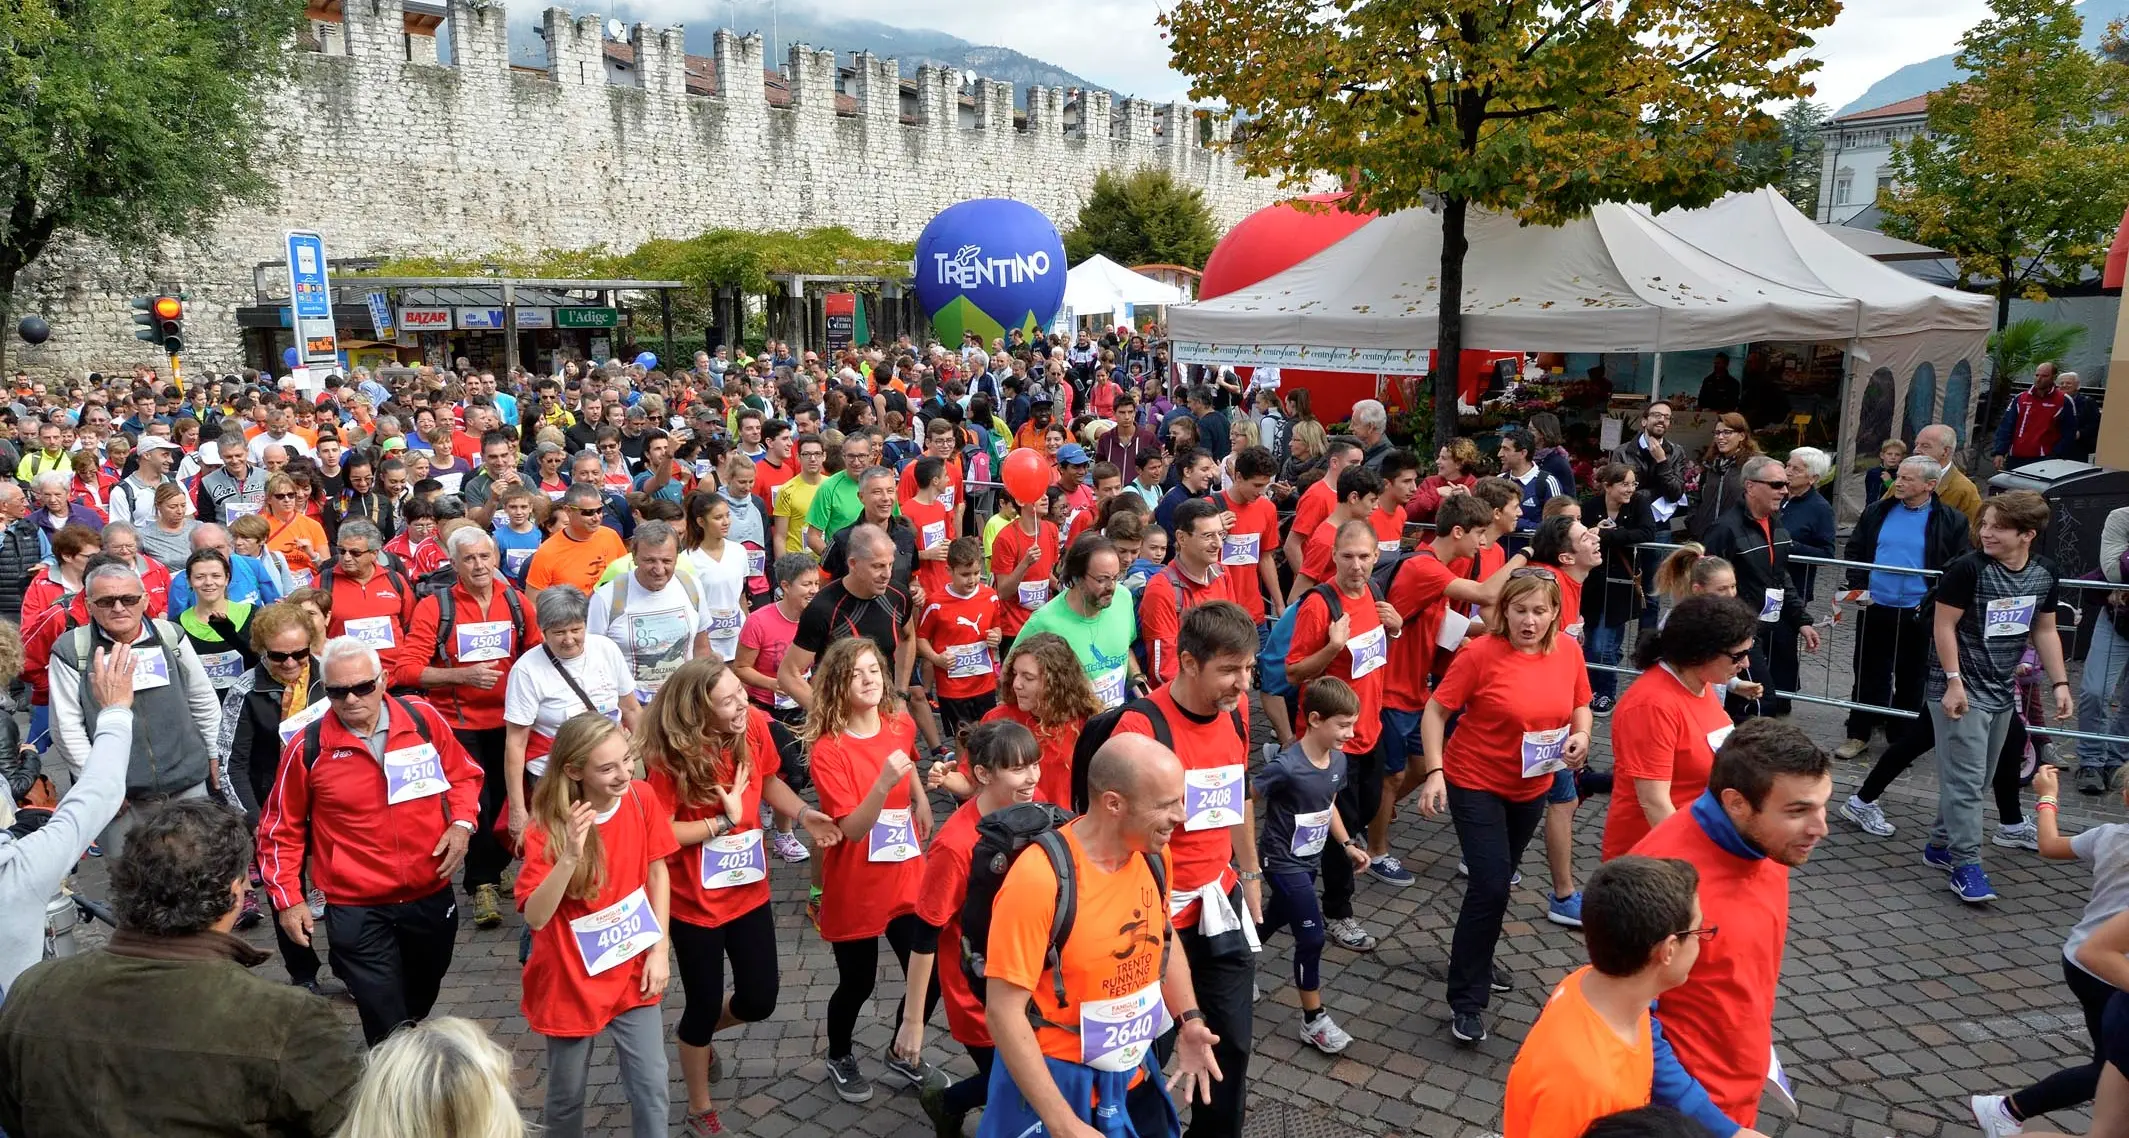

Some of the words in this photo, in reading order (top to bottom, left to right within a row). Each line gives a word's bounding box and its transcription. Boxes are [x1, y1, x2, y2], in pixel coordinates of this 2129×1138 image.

[934, 250, 1050, 289] TRENTINO
[405, 312, 448, 324] BAZAR
[568, 310, 609, 325] l'Adige
[1220, 344, 1252, 358] centrofiore
[1263, 345, 1298, 359] centrofiore
[1311, 346, 1348, 362] centrofiore
[1362, 349, 1402, 365] centrofiore
[1230, 544, 1252, 556] 2124
[1028, 590, 1045, 600] 2133
[715, 617, 738, 628] 2051
[1990, 610, 2025, 624] 3817
[358, 627, 385, 641] 4764
[470, 634, 501, 649] 4508
[636, 628, 658, 648] 85
[957, 653, 983, 667] 2053
[1361, 642, 1380, 661] 2070
[651, 666, 677, 675] BOLZANO
[402, 761, 436, 781] 4510
[1197, 787, 1232, 809] 2408
[717, 850, 754, 869] 4031
[597, 915, 641, 948] 4030
[1116, 953, 1152, 974] TRENTO
[1102, 964, 1150, 990] RUNNING
[1109, 977, 1149, 997] FESTIVAL
[1102, 1014, 1153, 1048] 2640
